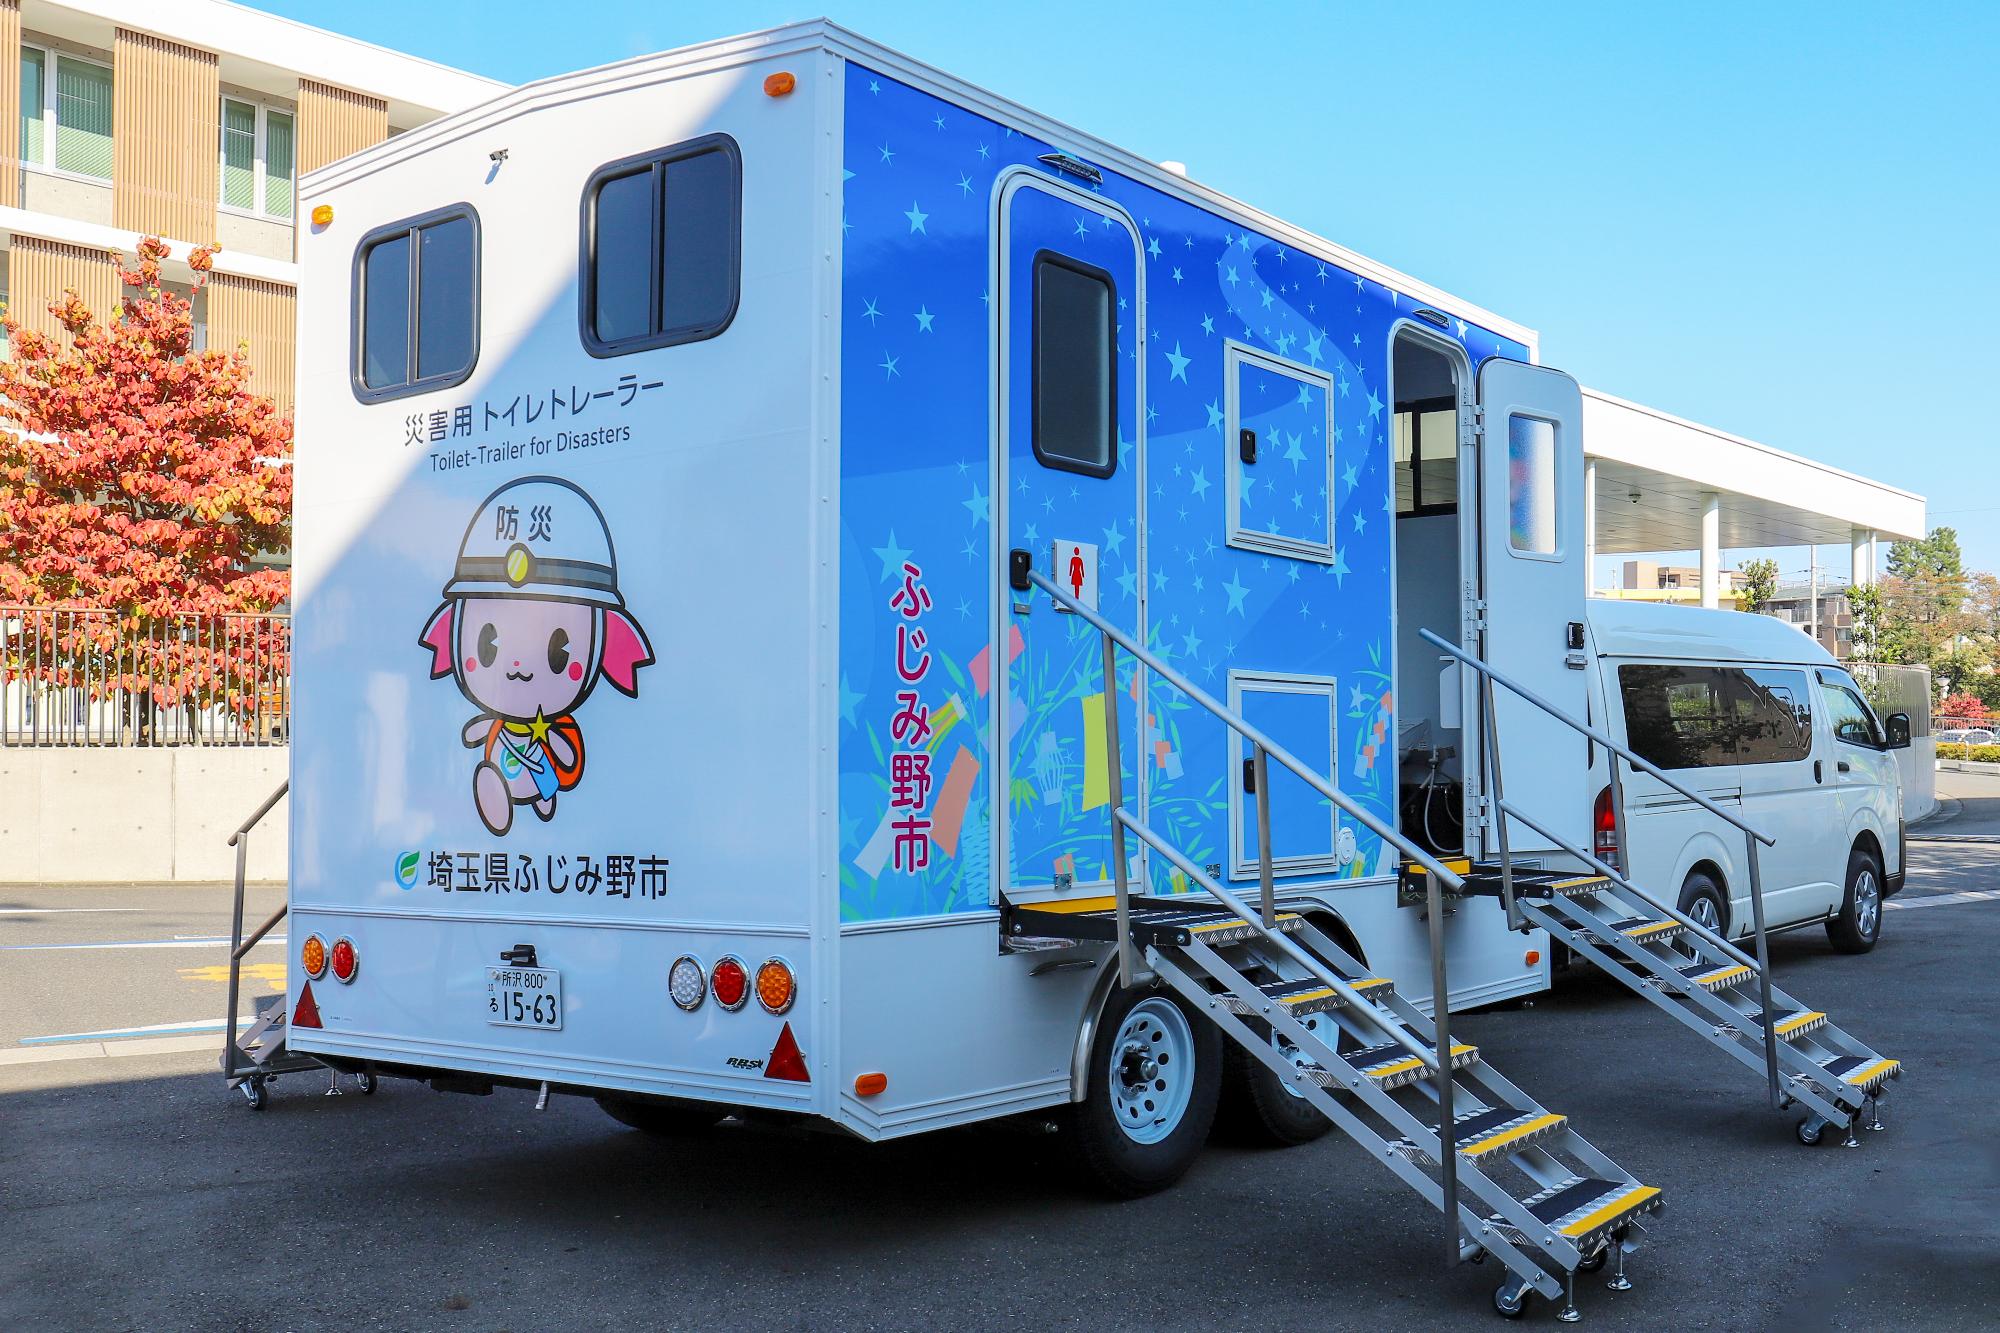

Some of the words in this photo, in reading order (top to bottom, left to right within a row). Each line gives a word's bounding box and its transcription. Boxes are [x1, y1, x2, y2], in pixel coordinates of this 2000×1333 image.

[430, 441, 526, 472] Toilet-Trailer
[530, 436, 552, 456] for
[557, 425, 630, 452] Disasters
[496, 505, 552, 542] 防災
[890, 562, 932, 873] ふじみ野市
[427, 850, 670, 900] 埼玉県ふじみ野市
[502, 971, 523, 988] 所沢
[525, 973, 543, 989] 800
[489, 997, 499, 1013] る
[503, 991, 557, 1025] 15-63
